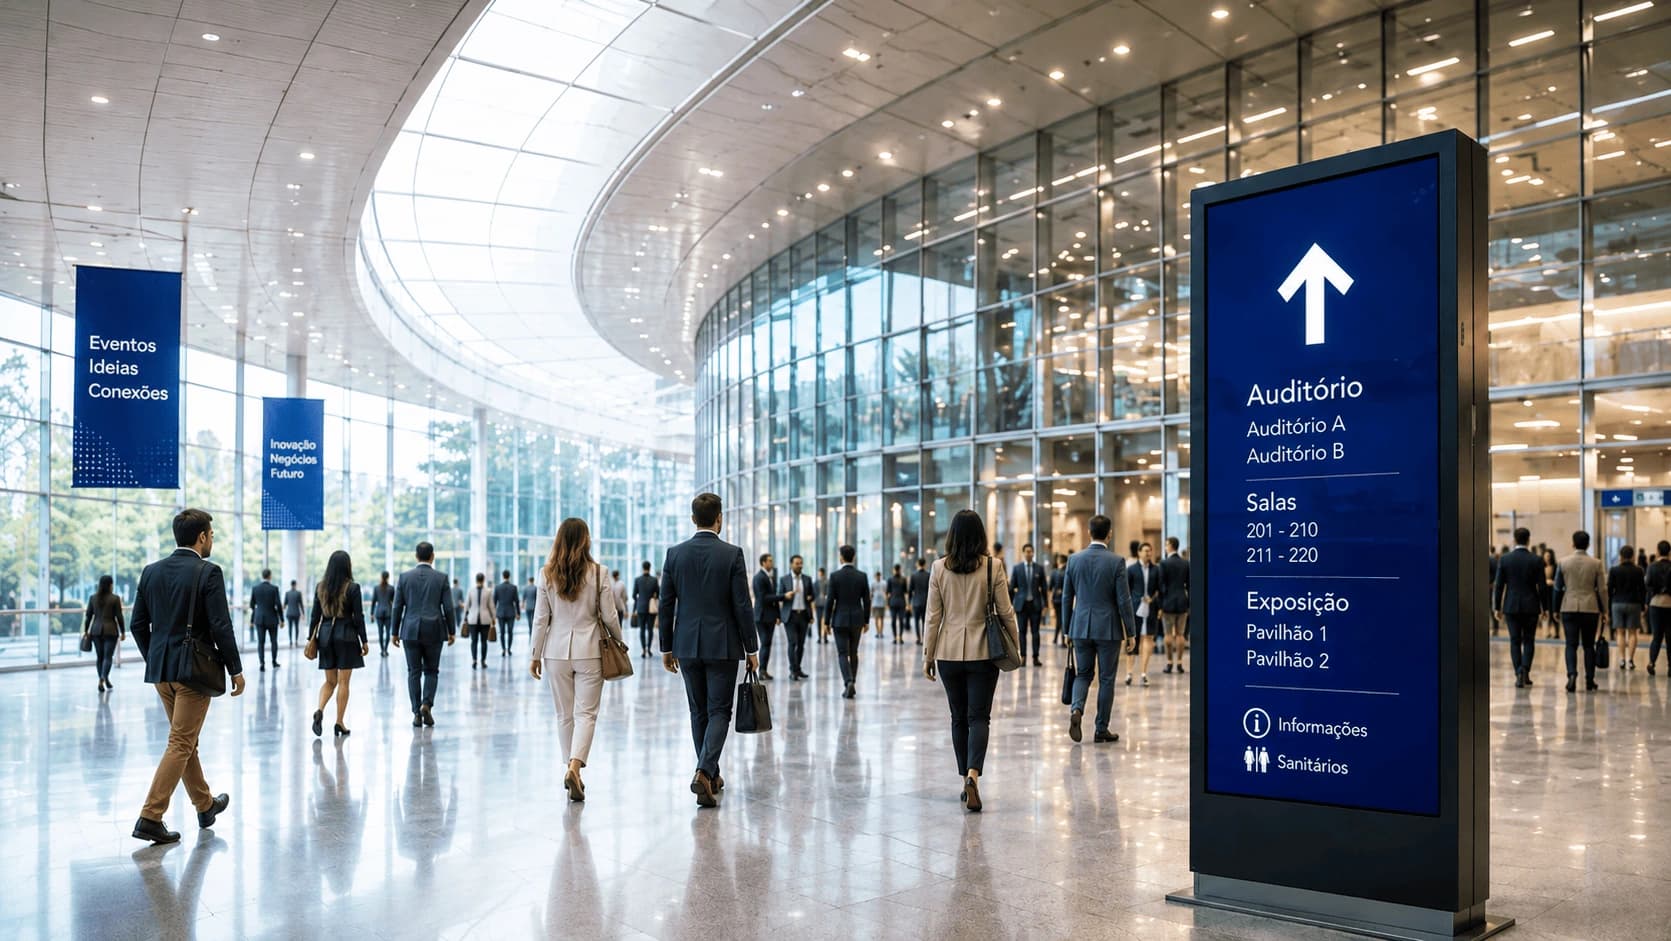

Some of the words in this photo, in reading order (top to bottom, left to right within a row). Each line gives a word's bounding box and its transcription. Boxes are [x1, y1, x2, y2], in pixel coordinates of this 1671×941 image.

[90, 336, 156, 352] Eventos
[90, 359, 138, 375] Ideias
[89, 383, 168, 400] Conexões
[1247, 376, 1362, 406] Auditório
[1247, 417, 1326, 437] Auditório
[1332, 415, 1345, 431] A
[270, 439, 317, 452] Inovação
[1247, 445, 1326, 464] Auditório
[1333, 443, 1344, 459] B
[270, 453, 318, 467] Negócios
[270, 468, 304, 479] Futuro
[1247, 491, 1296, 511] Salas
[1247, 523, 1271, 538] 201
[1290, 522, 1318, 537] 210
[1247, 548, 1271, 562] 211
[1289, 547, 1318, 562] 220
[1248, 592, 1349, 616] Exposição
[1247, 624, 1313, 641] Pavilhão
[1319, 626, 1327, 642] 1
[1248, 650, 1313, 668] Pavilhão
[1319, 653, 1329, 669] 2
[1279, 717, 1367, 739] Informações
[1278, 754, 1348, 774] Sanitários
